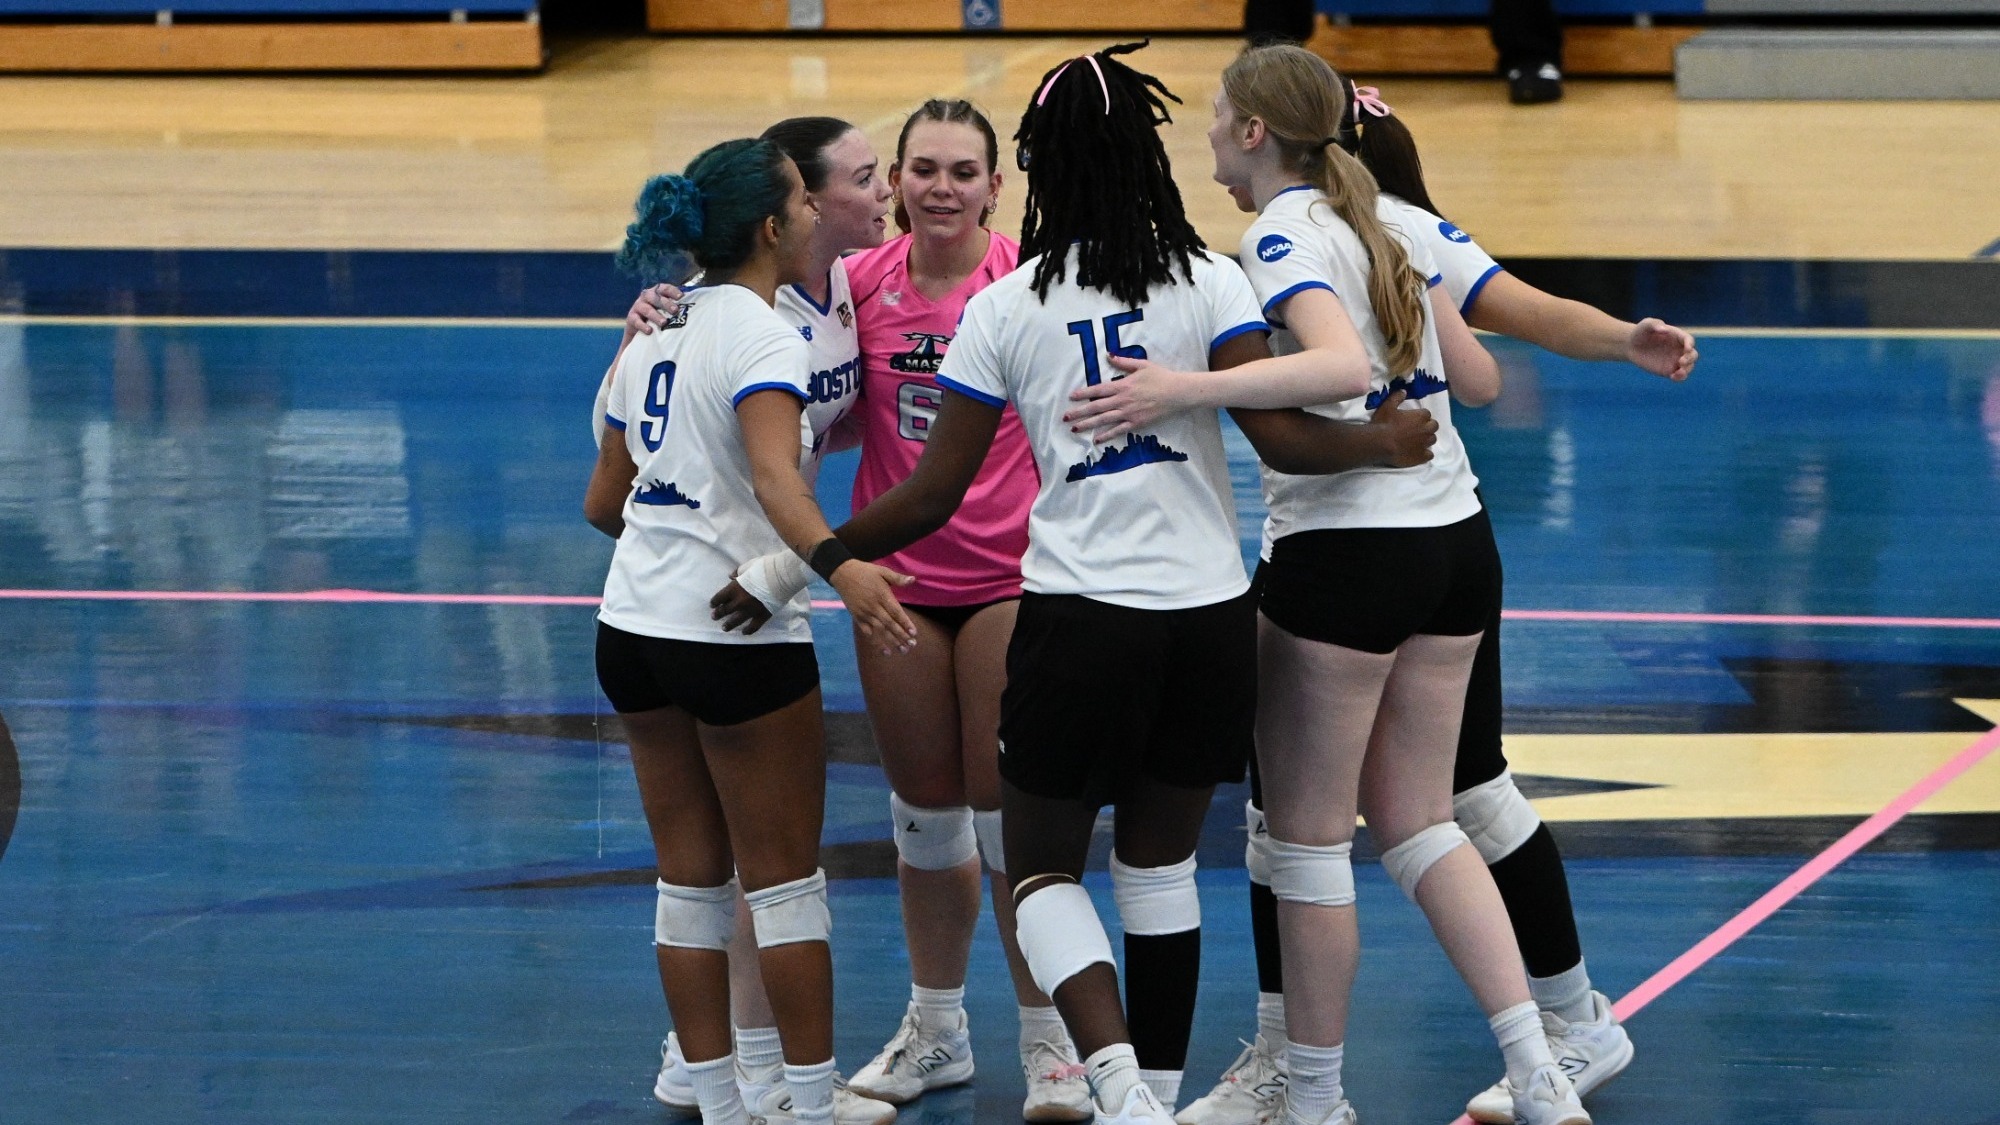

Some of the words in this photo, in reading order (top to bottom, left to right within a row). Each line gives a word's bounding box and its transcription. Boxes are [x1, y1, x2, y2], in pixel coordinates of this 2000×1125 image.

[1262, 242, 1292, 260] NCAA
[1066, 307, 1148, 402] 15
[640, 360, 677, 453] 9
[897, 382, 945, 442] 6
